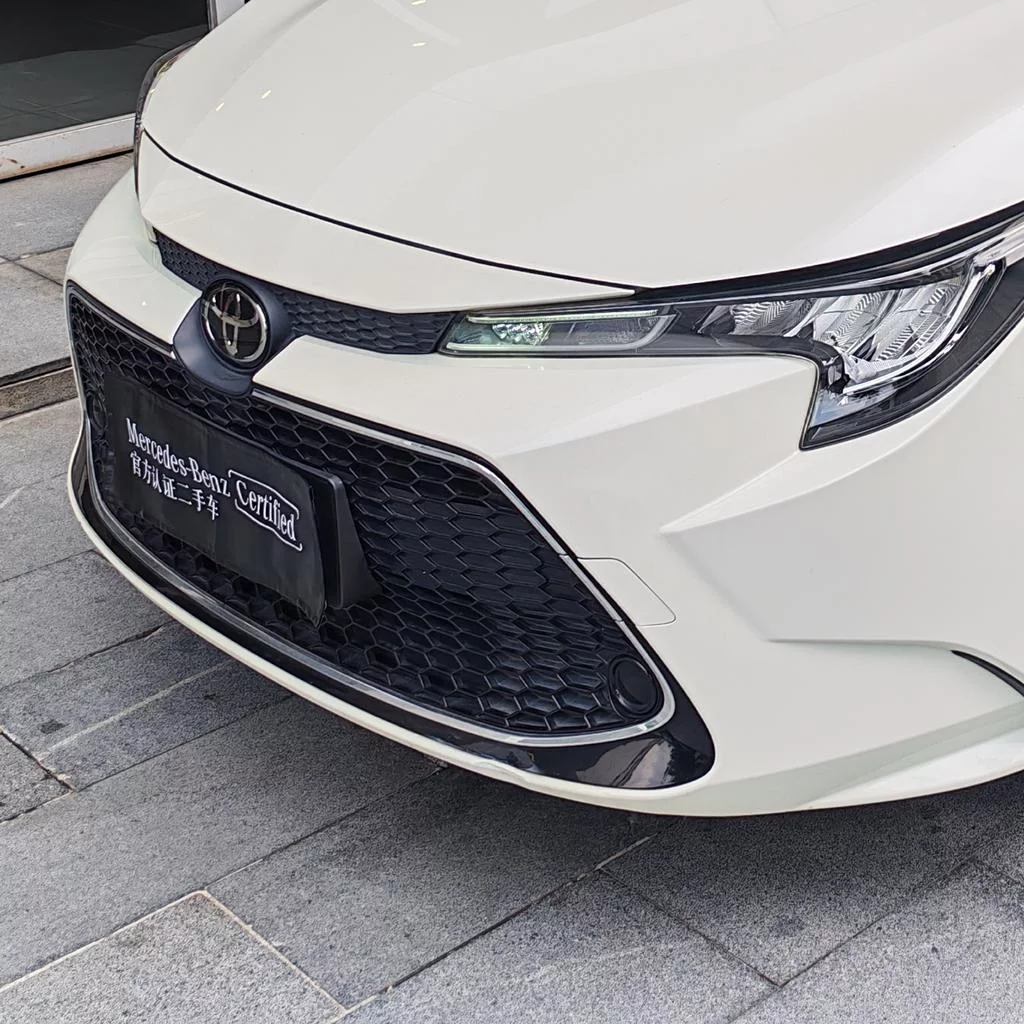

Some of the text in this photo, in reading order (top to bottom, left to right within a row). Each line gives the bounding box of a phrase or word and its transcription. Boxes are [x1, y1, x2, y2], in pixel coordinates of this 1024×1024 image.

[126, 417, 297, 542] Mercedes-Benz Certified
[130, 451, 219, 520] 官方认证二手车
